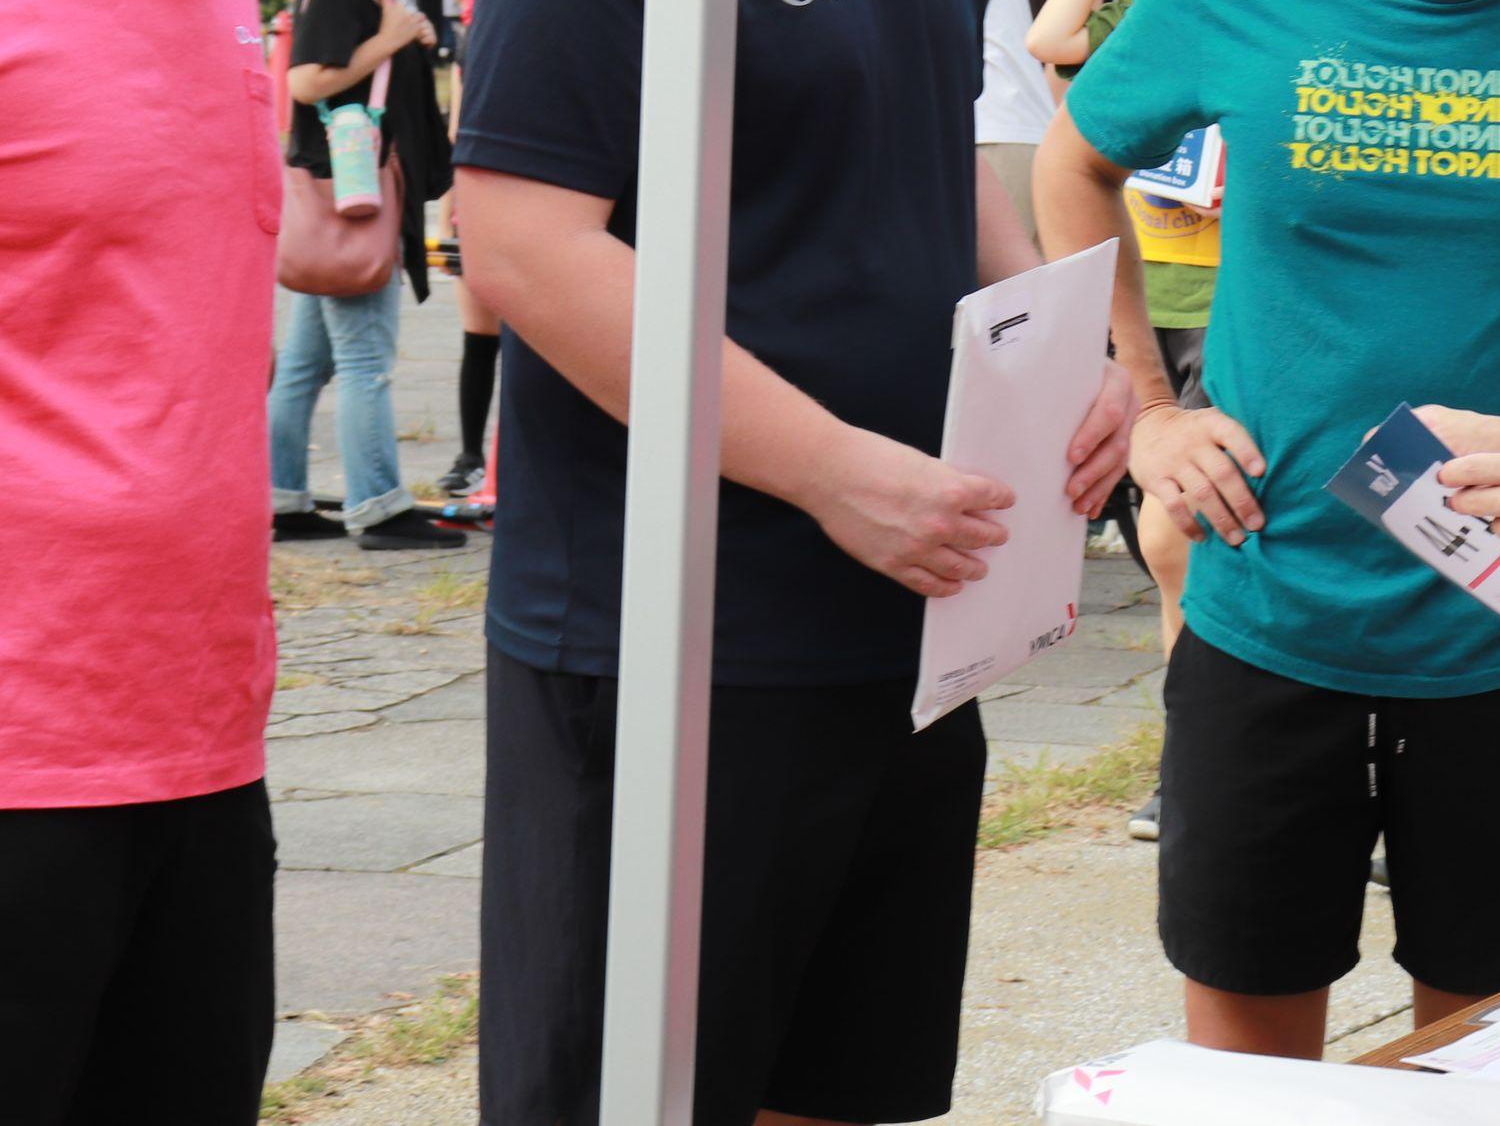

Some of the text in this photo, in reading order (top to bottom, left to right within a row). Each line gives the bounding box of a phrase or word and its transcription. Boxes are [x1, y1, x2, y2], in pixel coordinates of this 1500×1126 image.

[1294, 57, 1413, 90] TOUGH
[1295, 87, 1413, 119] TOUGH
[1292, 115, 1411, 147] TOUGH
[1287, 143, 1410, 174] TOUGH
